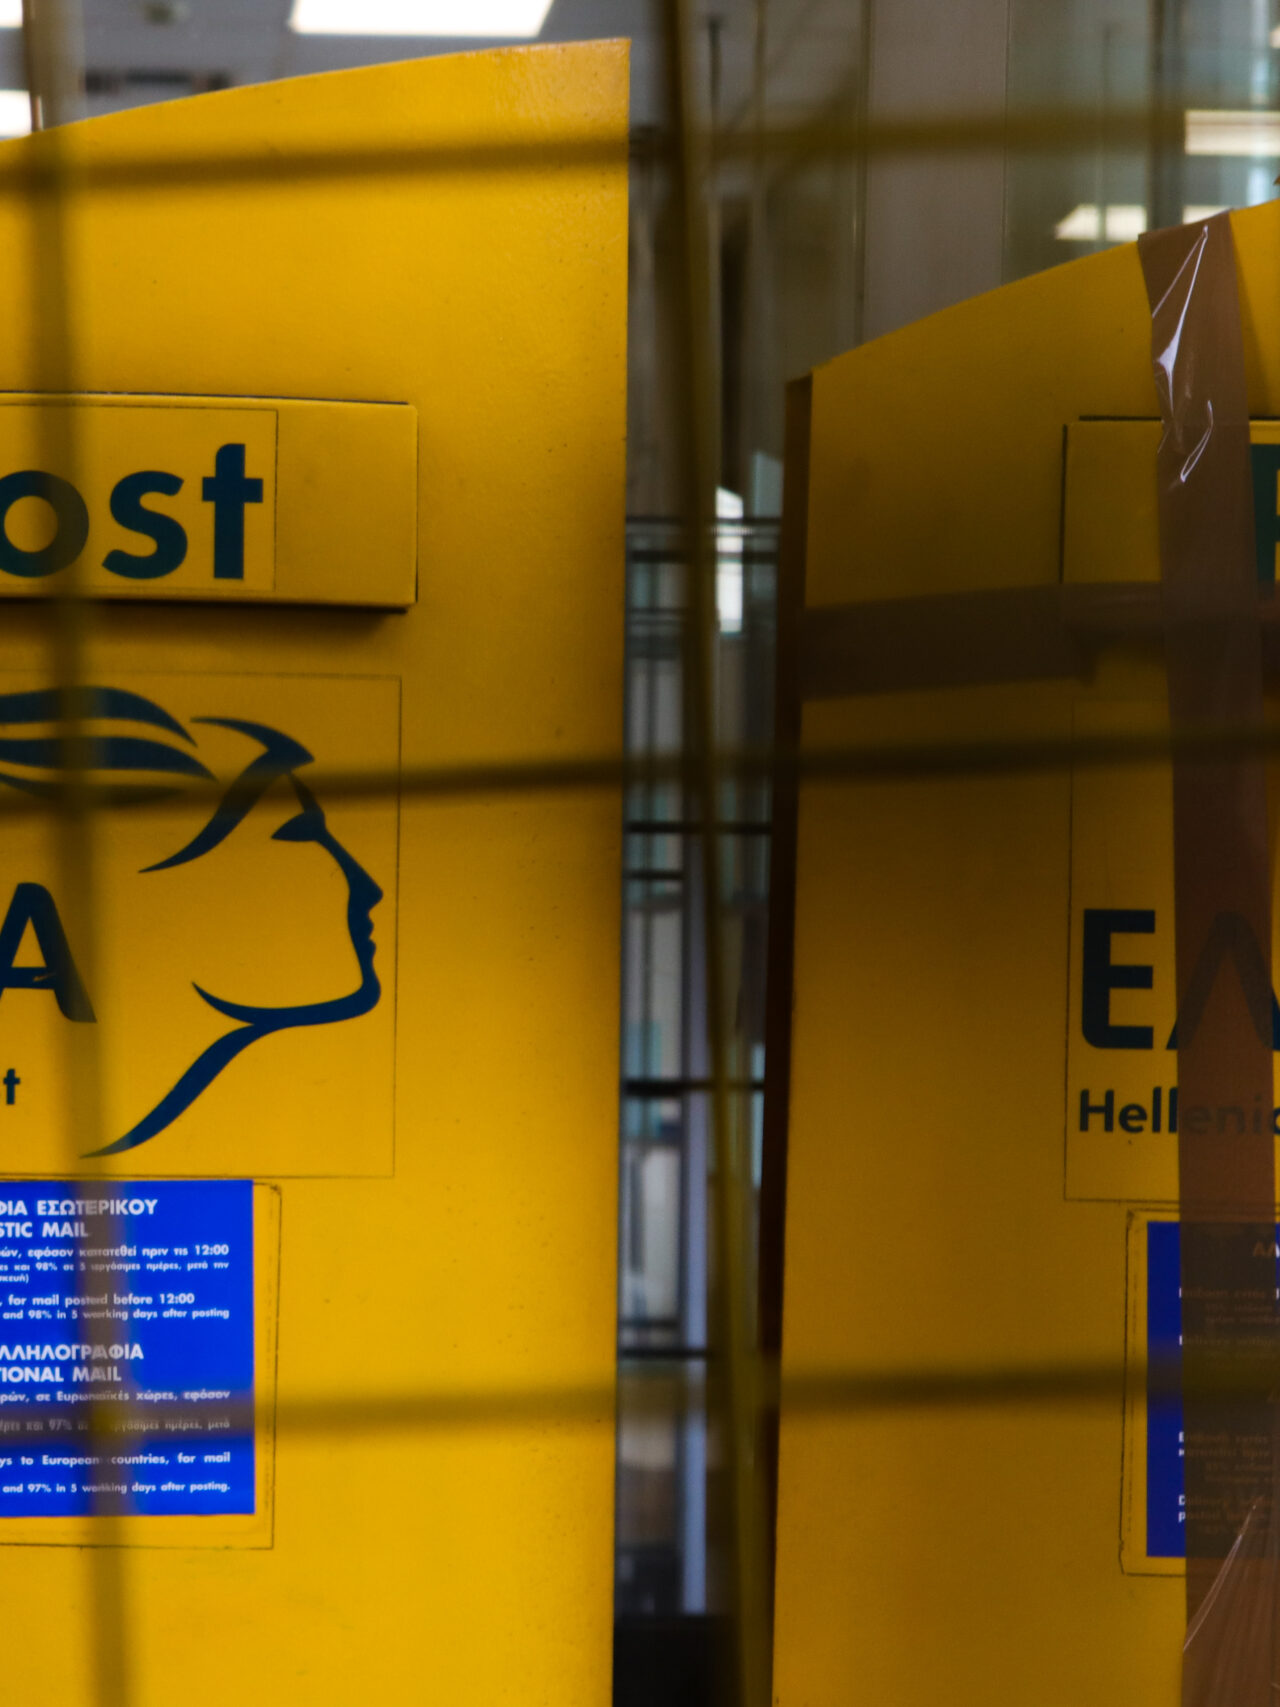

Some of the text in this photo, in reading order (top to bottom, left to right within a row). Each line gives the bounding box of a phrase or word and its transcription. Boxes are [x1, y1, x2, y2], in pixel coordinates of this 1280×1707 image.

[37, 1199, 159, 1216] ΕΣΩΤΕΡΙΚΟΥ
[42, 1221, 89, 1238] MAIL
[195, 1243, 229, 1256] 12:00
[35, 1262, 58, 1271] 98%
[8, 1294, 27, 1306] for
[32, 1294, 60, 1306] mail
[113, 1293, 153, 1305] before
[159, 1293, 195, 1304] 12:00
[2, 1310, 24, 1319] and
[28, 1310, 52, 1319] 98%
[57, 1310, 67, 1319] in
[71, 1310, 78, 1319] 5
[132, 1309, 158, 1320] days
[162, 1308, 188, 1318] after
[192, 1308, 230, 1320] posting
[72, 1366, 122, 1382] MAIL
[20, 1455, 34, 1465] to
[42, 1454, 100, 1468] European
[109, 1453, 170, 1465] countries,
[177, 1451, 196, 1463] for
[204, 1451, 231, 1463] mail
[2, 1483, 24, 1493] and
[27, 1483, 52, 1493] 97%
[56, 1483, 66, 1493] in
[71, 1483, 77, 1493] 5
[132, 1482, 157, 1494] days
[161, 1481, 186, 1491] after
[190, 1481, 231, 1493] posting.
